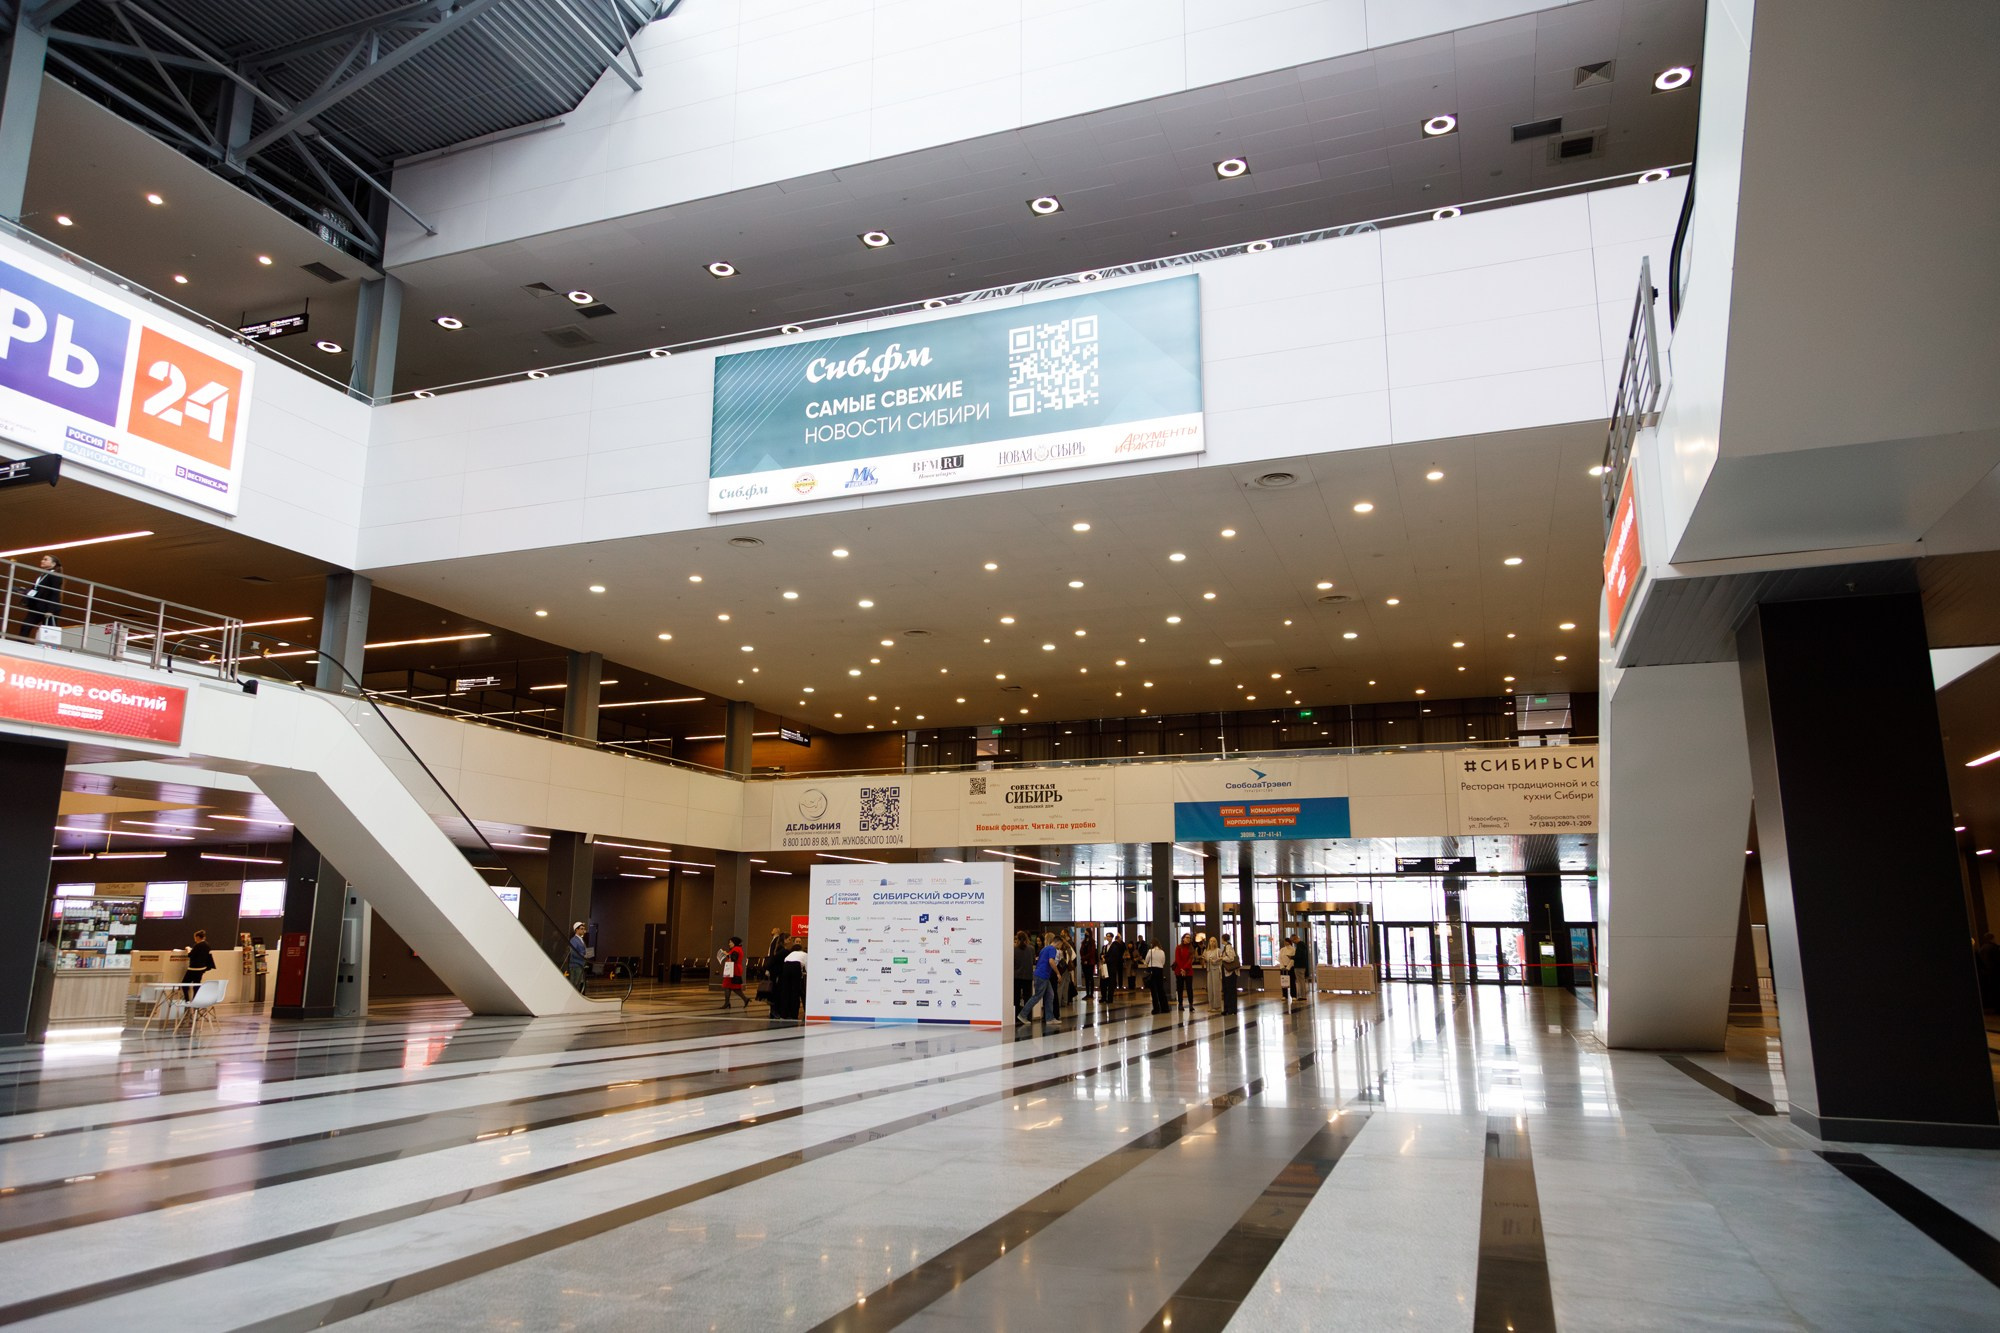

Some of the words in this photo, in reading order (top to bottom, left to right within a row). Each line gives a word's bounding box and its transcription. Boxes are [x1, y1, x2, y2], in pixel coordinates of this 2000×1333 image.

[806, 343, 933, 384] Сиб.фм
[144, 360, 230, 443] 24
[806, 395, 876, 419] САМЫЕ
[881, 380, 964, 408] СВЕЖИЕ
[805, 418, 902, 445] НОВОСТИ
[907, 403, 990, 431] СИБИРИ
[68, 429, 104, 448] РОССИЯ
[107, 441, 119, 453] 24
[1119, 426, 1198, 448] АРГУМЕНТЫ
[999, 448, 1033, 465] НОВАЯ
[1050, 441, 1085, 458] СИБИРЬ
[852, 467, 877, 482] МК
[719, 483, 768, 501] Сиб.фм
[11, 673, 85, 698] центре
[88, 687, 168, 712] событий
[1010, 783, 1056, 791] СОВЕТСКАЯ
[1225, 781, 1292, 790] СвободаТрэвел
[1461, 782, 1505, 793] Ресторан
[1508, 780, 1578, 791] традиционной
[1005, 790, 1063, 804] СИБИРЬ
[1523, 793, 1552, 803] кухни
[1554, 791, 1594, 801] Сибири
[1250, 806, 1300, 815] КОМАНДИРОВКИ
[786, 822, 841, 832] ДЕЛЬФИНИЯ
[1001, 823, 1030, 832] формат.
[1071, 821, 1096, 830] удобно
[1226, 818, 1277, 826] КОРПОРАТИВНЫЕ
[782, 838, 787, 847] 8
[788, 837, 799, 847] 800
[800, 837, 811, 847] 100
[812, 837, 820, 847] 89
[831, 836, 841, 846] УЛ.
[842, 835, 885, 846] ЖУКОВСКОГО
[885, 835, 903, 845] 100/4
[873, 891, 940, 900] СИБИРСКИЙ
[942, 892, 985, 900] ФОРУМ
